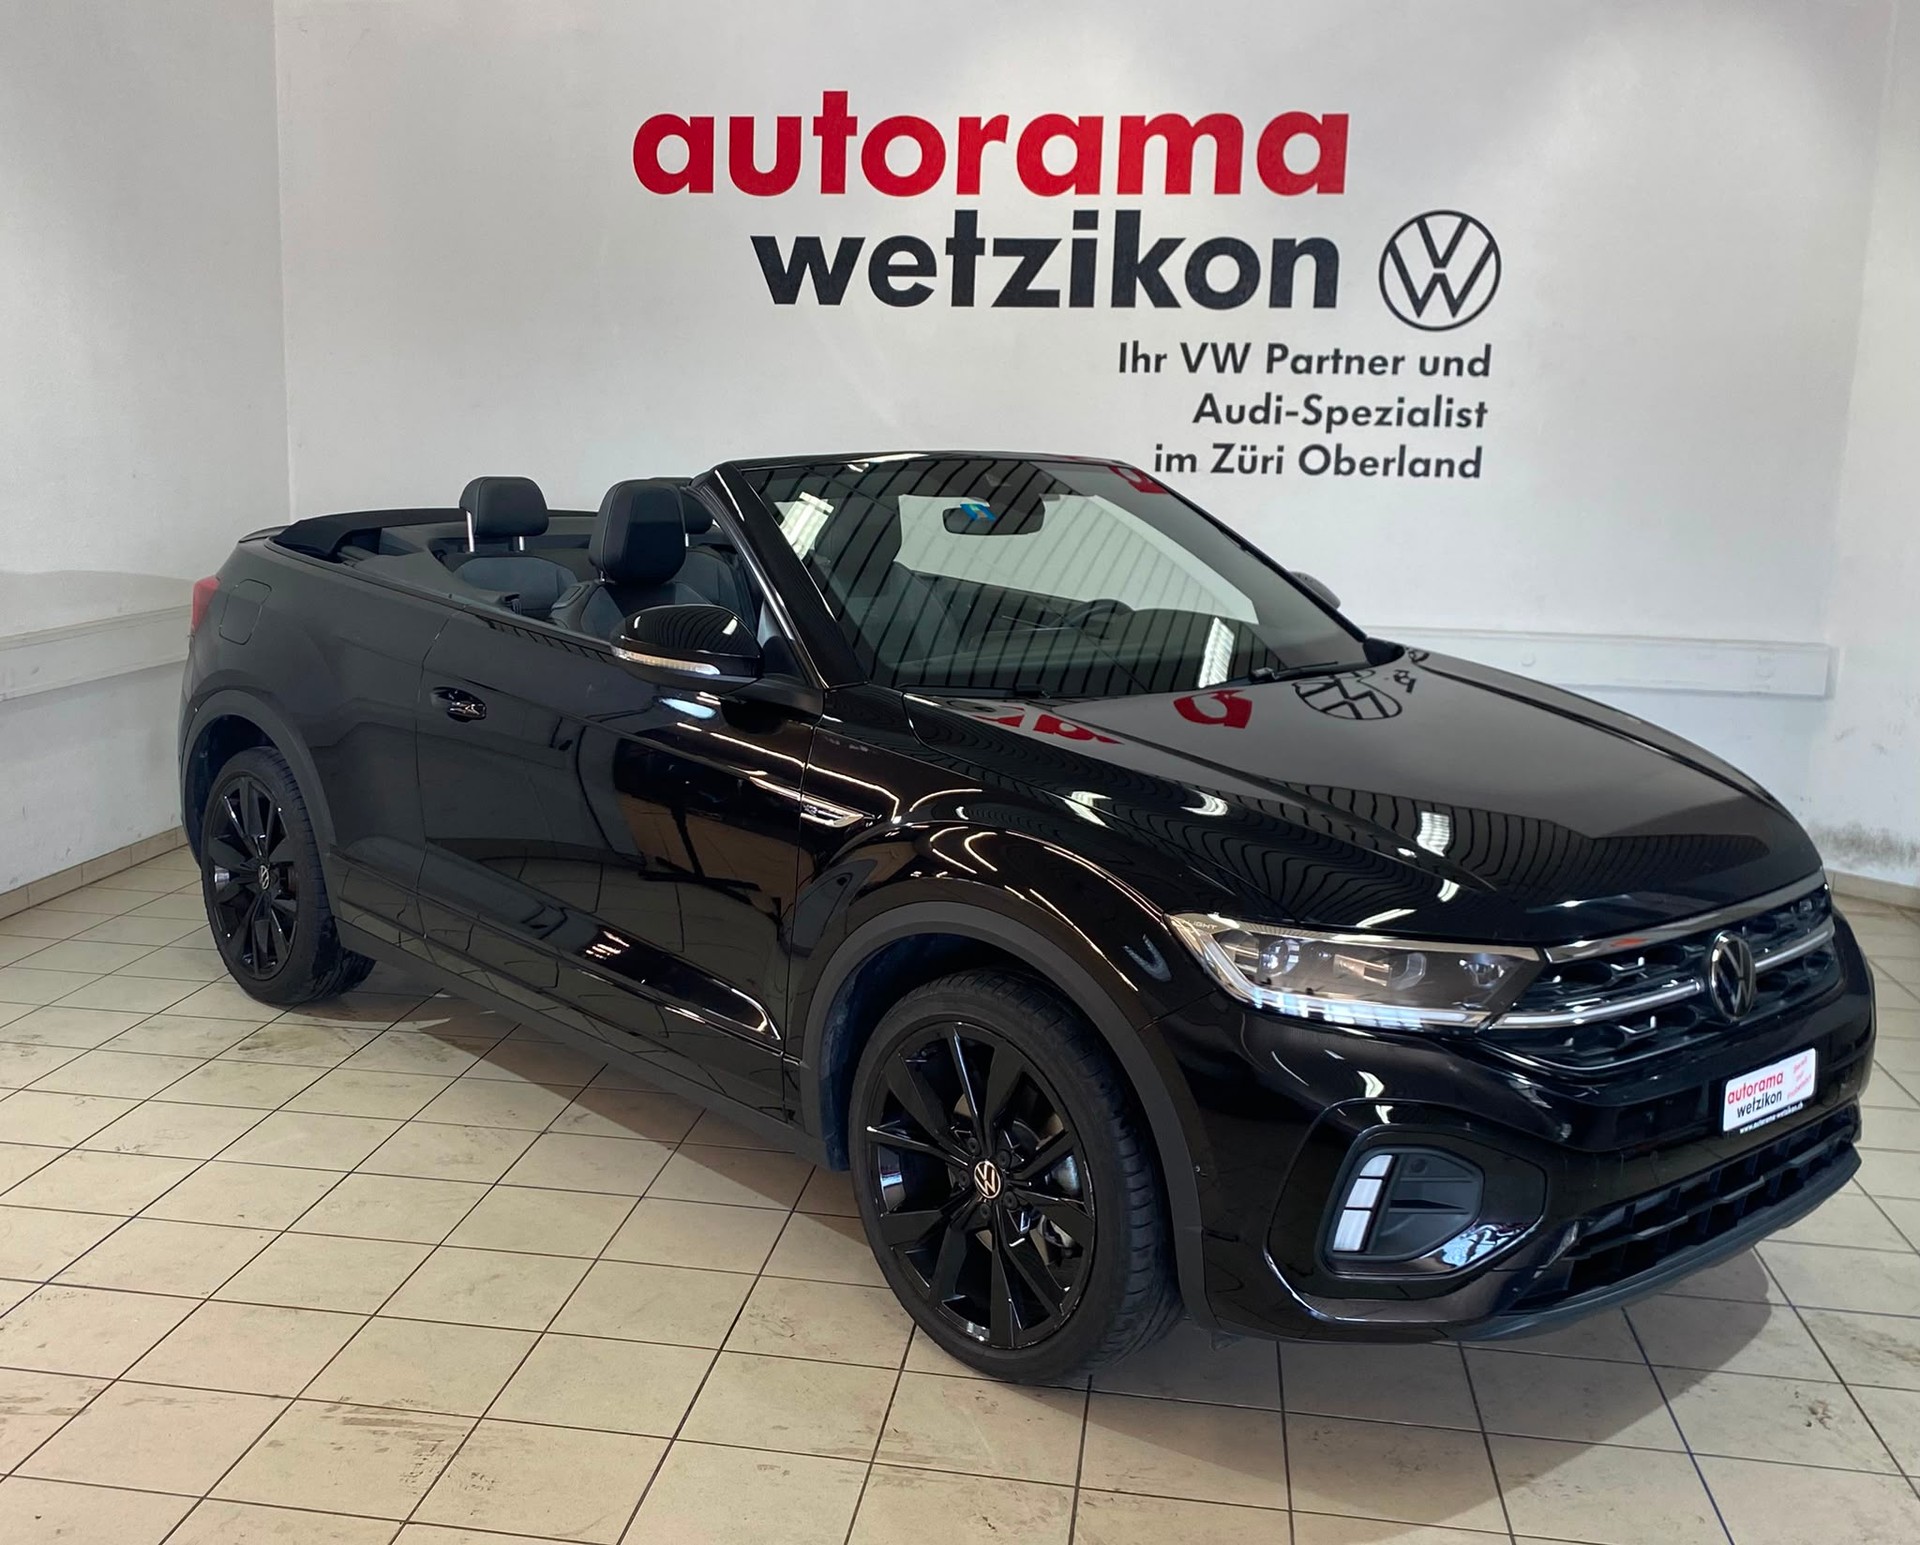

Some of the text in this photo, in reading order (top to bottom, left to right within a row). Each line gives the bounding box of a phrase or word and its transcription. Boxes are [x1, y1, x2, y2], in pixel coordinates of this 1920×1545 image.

[633, 91, 1348, 196] autorama
[750, 210, 1339, 309] wetzikon
[1379, 210, 1501, 331] VW
[1119, 341, 1492, 377] Ihr VW Partner und
[1192, 393, 1489, 433] Audi-Spezialist
[1154, 443, 1482, 478] im Züri Oberland
[1727, 1072, 1784, 1105] autorama
[1736, 1090, 1783, 1119] wetzikon
